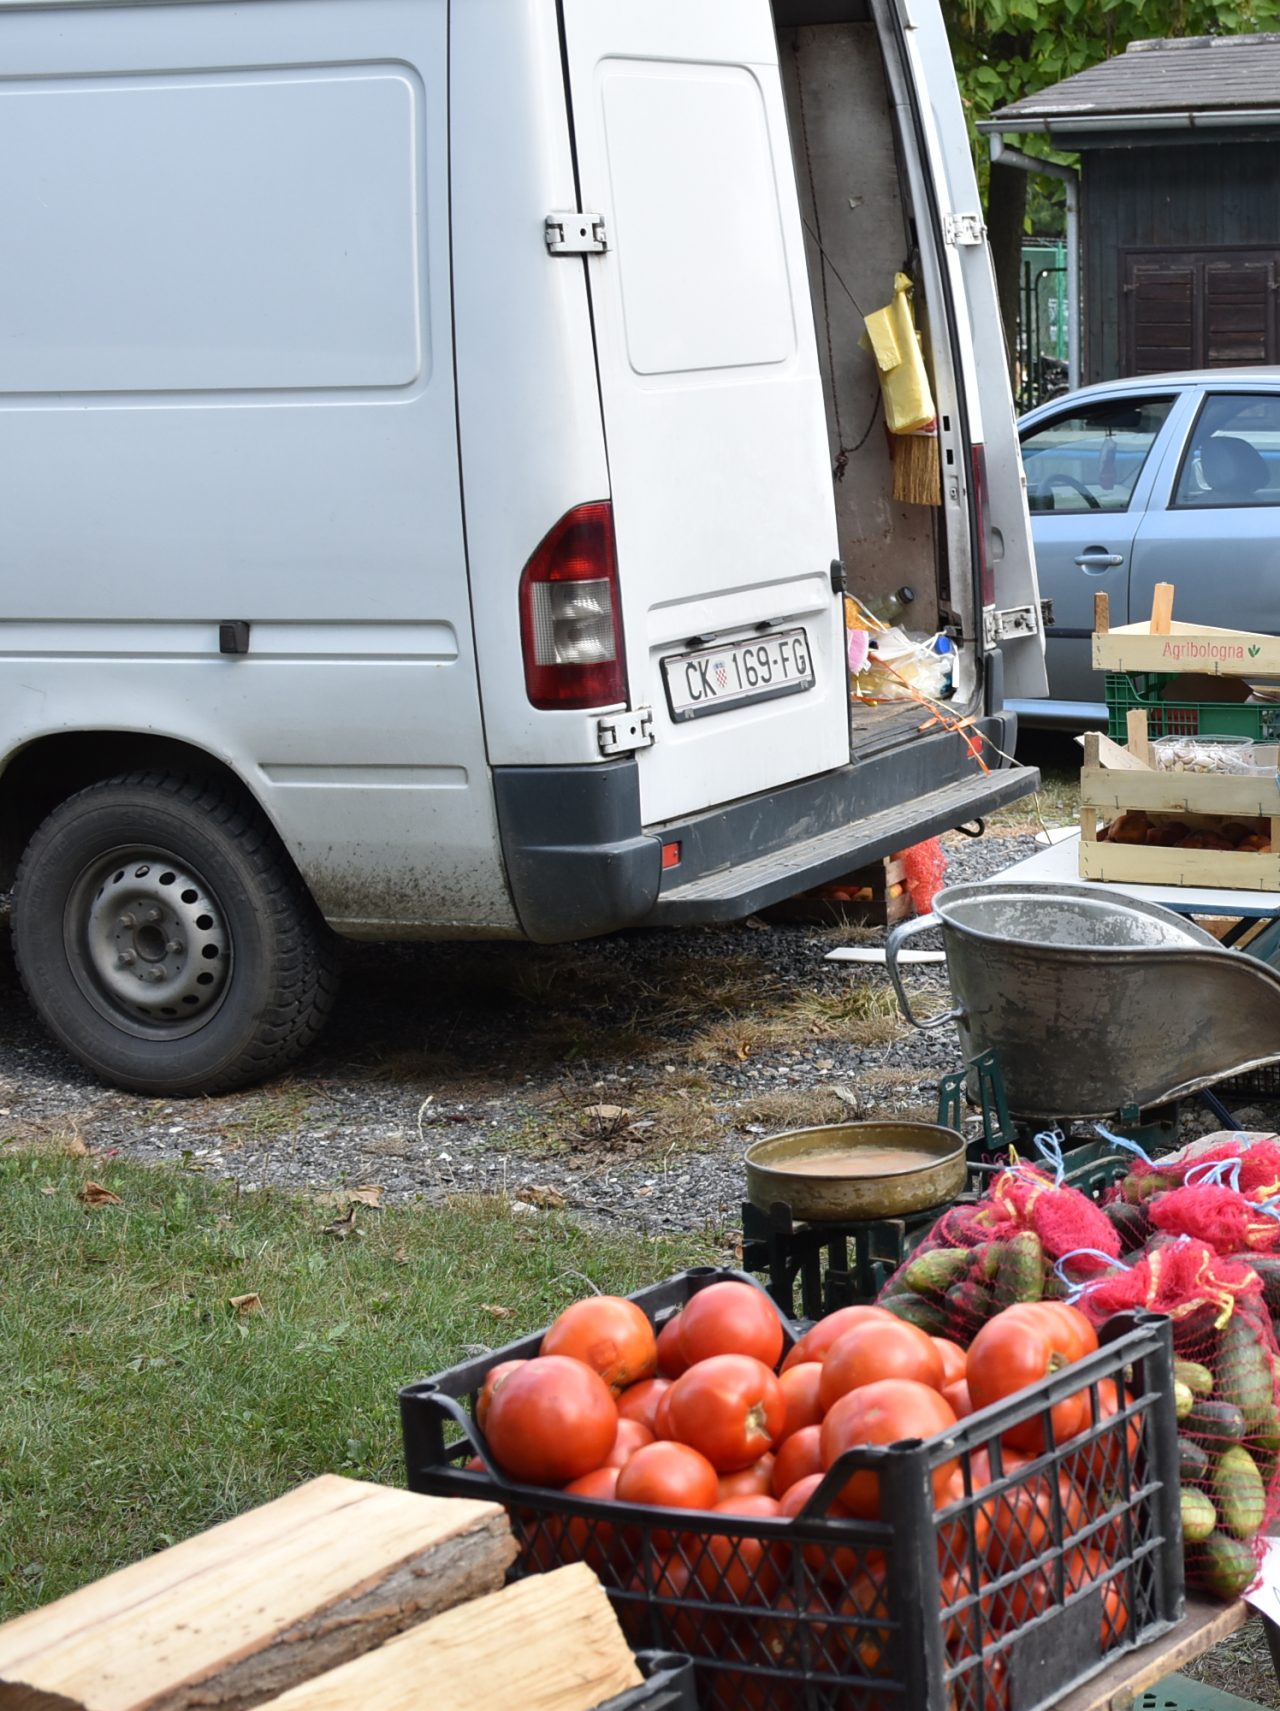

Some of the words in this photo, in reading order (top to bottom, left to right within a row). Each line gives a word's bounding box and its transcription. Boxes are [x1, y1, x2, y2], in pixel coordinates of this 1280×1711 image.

[685, 659, 717, 701] ČK
[732, 638, 807, 690] 169-FG
[1162, 642, 1244, 661] Agribologna
